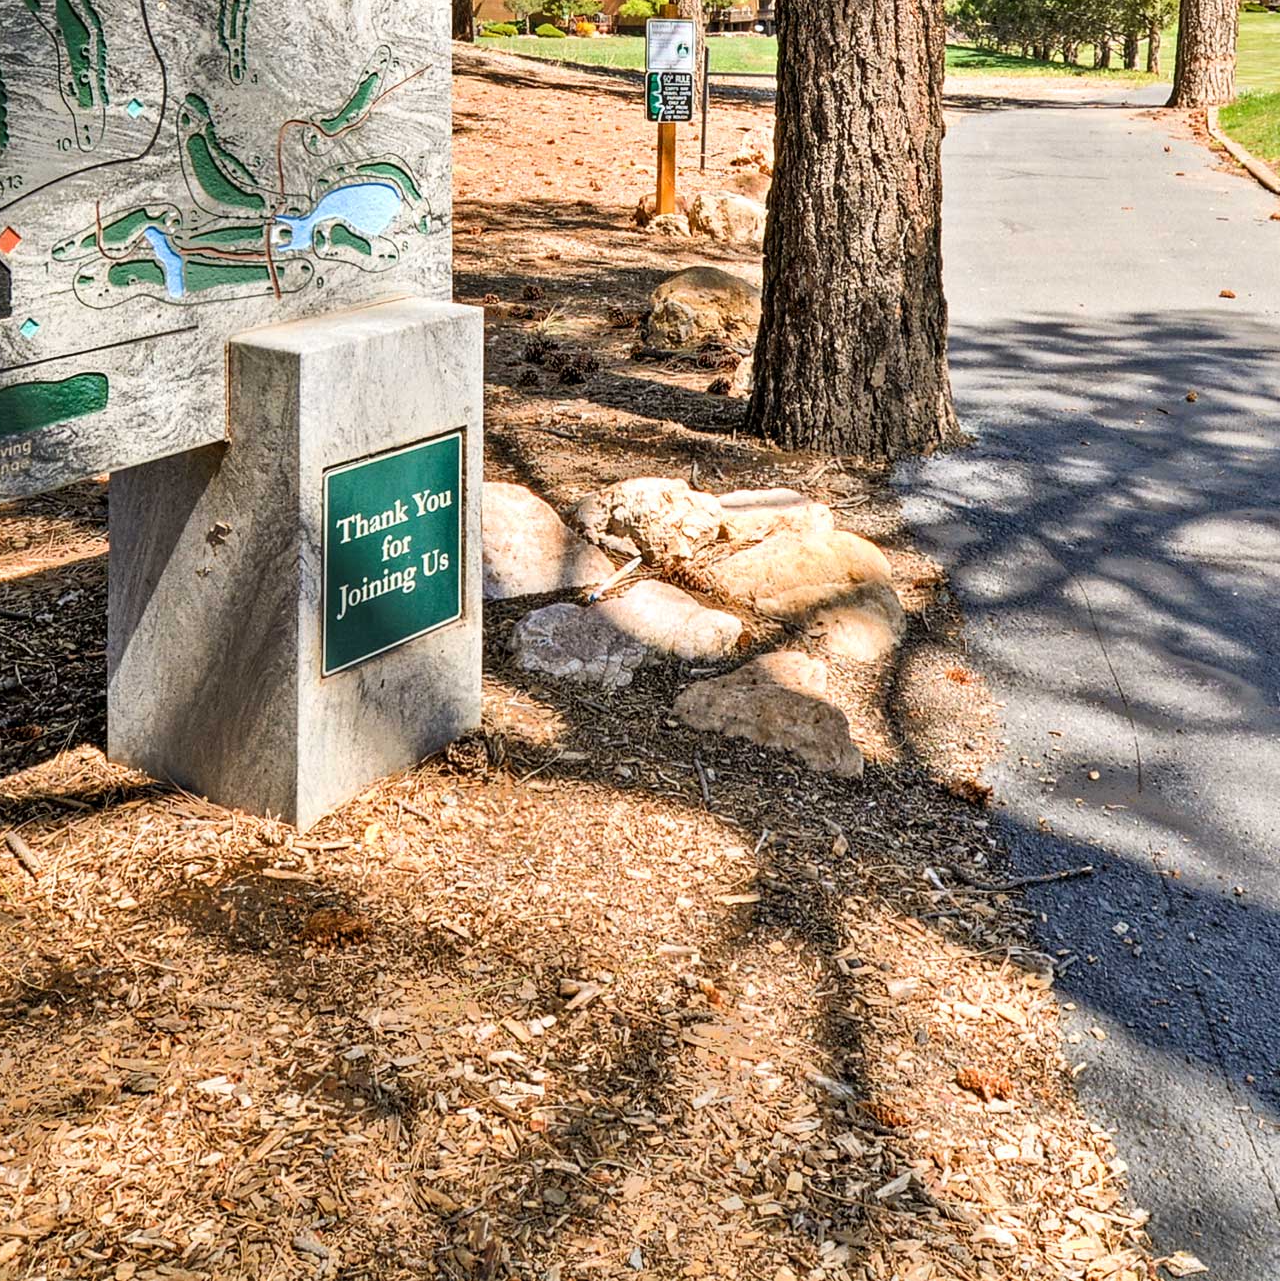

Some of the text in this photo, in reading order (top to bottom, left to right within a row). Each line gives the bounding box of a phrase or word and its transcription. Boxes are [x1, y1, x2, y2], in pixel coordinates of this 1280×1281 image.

[56, 138, 71, 151] 10
[316, 276, 324, 288] 9
[336, 489, 452, 544] Thank You
[381, 535, 412, 562] for
[336, 549, 449, 620] Joining Us
